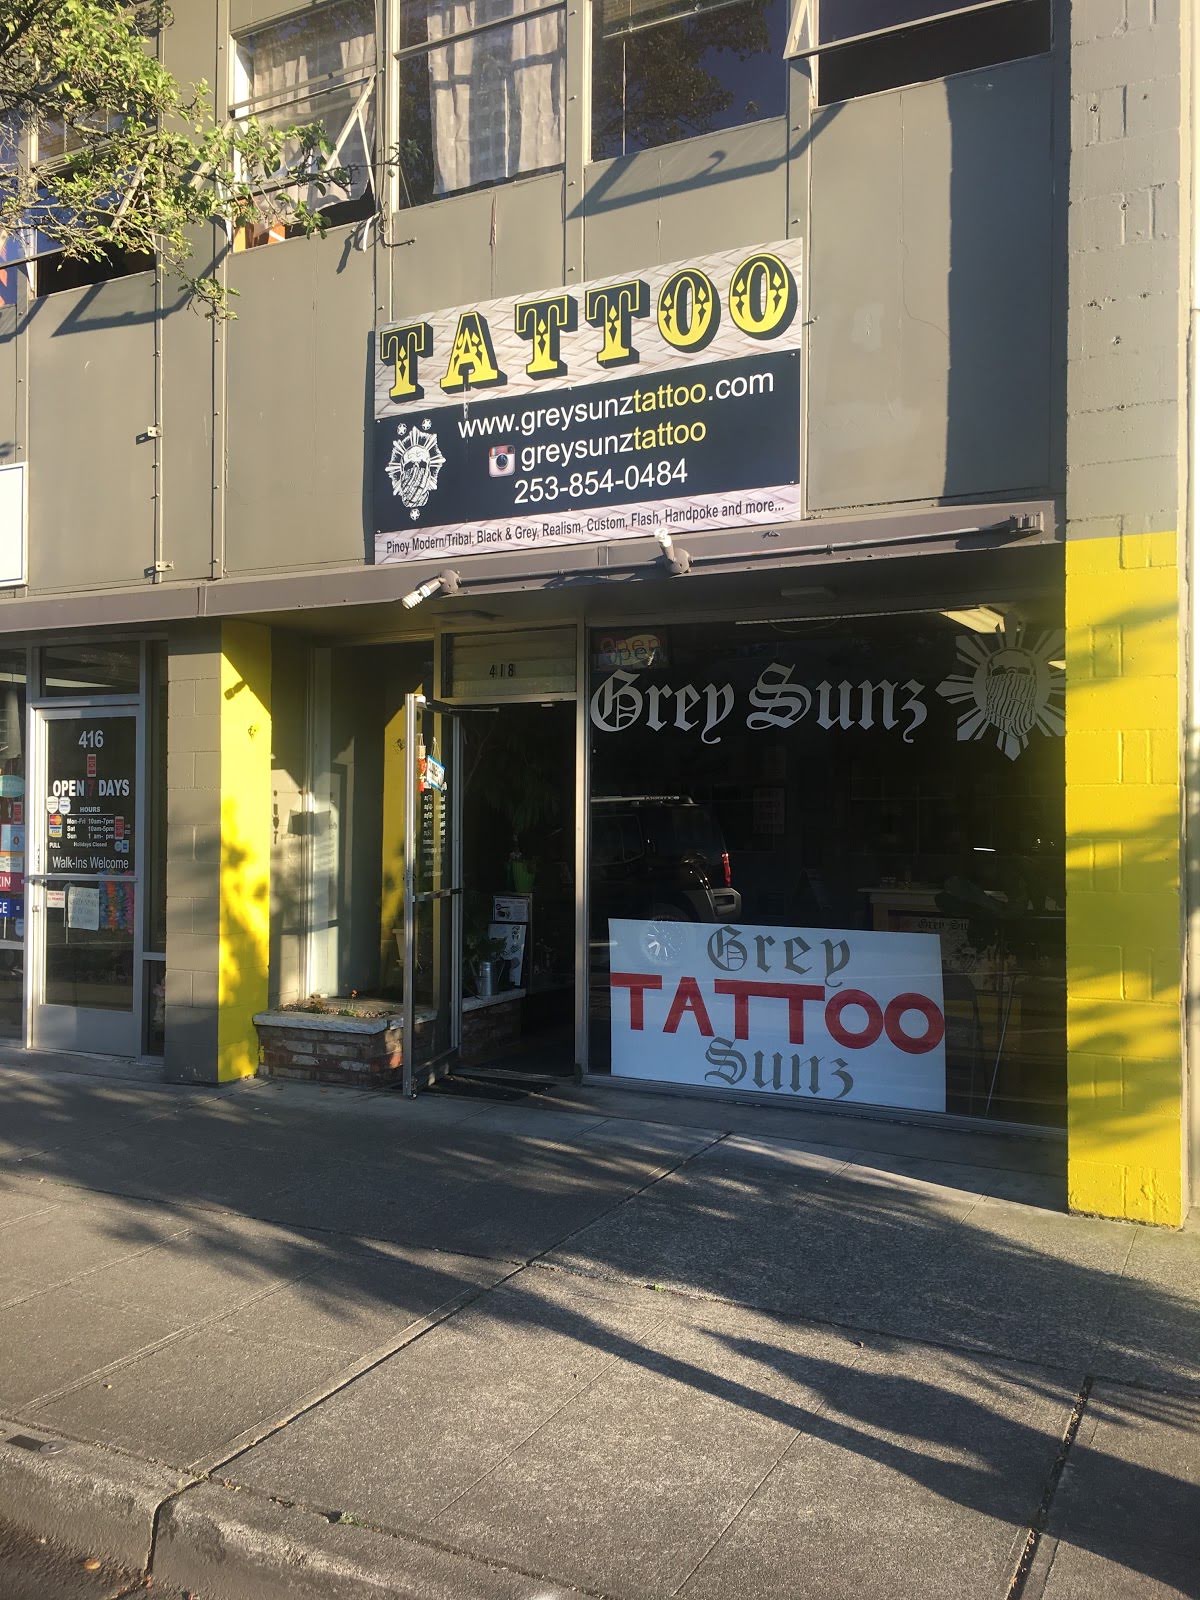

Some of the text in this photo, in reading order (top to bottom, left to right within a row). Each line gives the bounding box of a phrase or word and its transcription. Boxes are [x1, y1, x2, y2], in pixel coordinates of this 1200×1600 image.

[380, 252, 798, 403] TATTOO
[457, 371, 775, 439] www.greysunztattoo.com
[520, 421, 707, 472] greysunztattoo
[513, 457, 689, 505] 253-854-0484
[386, 541, 410, 555] Pinoy
[477, 529, 502, 544] Black
[505, 527, 512, 540] &
[542, 521, 584, 537] Realism,
[586, 516, 628, 532] Custom,
[631, 511, 662, 527] Flash,
[665, 504, 719, 524] Handpoke
[722, 500, 742, 516] and
[745, 499, 784, 515] more...
[489, 663, 514, 678] 418
[589, 662, 928, 745] Grey Sunz
[79, 730, 104, 748] 416
[52, 780, 85, 797] OPEN
[98, 779, 130, 797] DAYS
[52, 855, 129, 869] Walk-Ins Welcome
[706, 924, 852, 988] Grey
[609, 971, 946, 1055] TATTOO
[704, 1035, 854, 1100] Sunz
